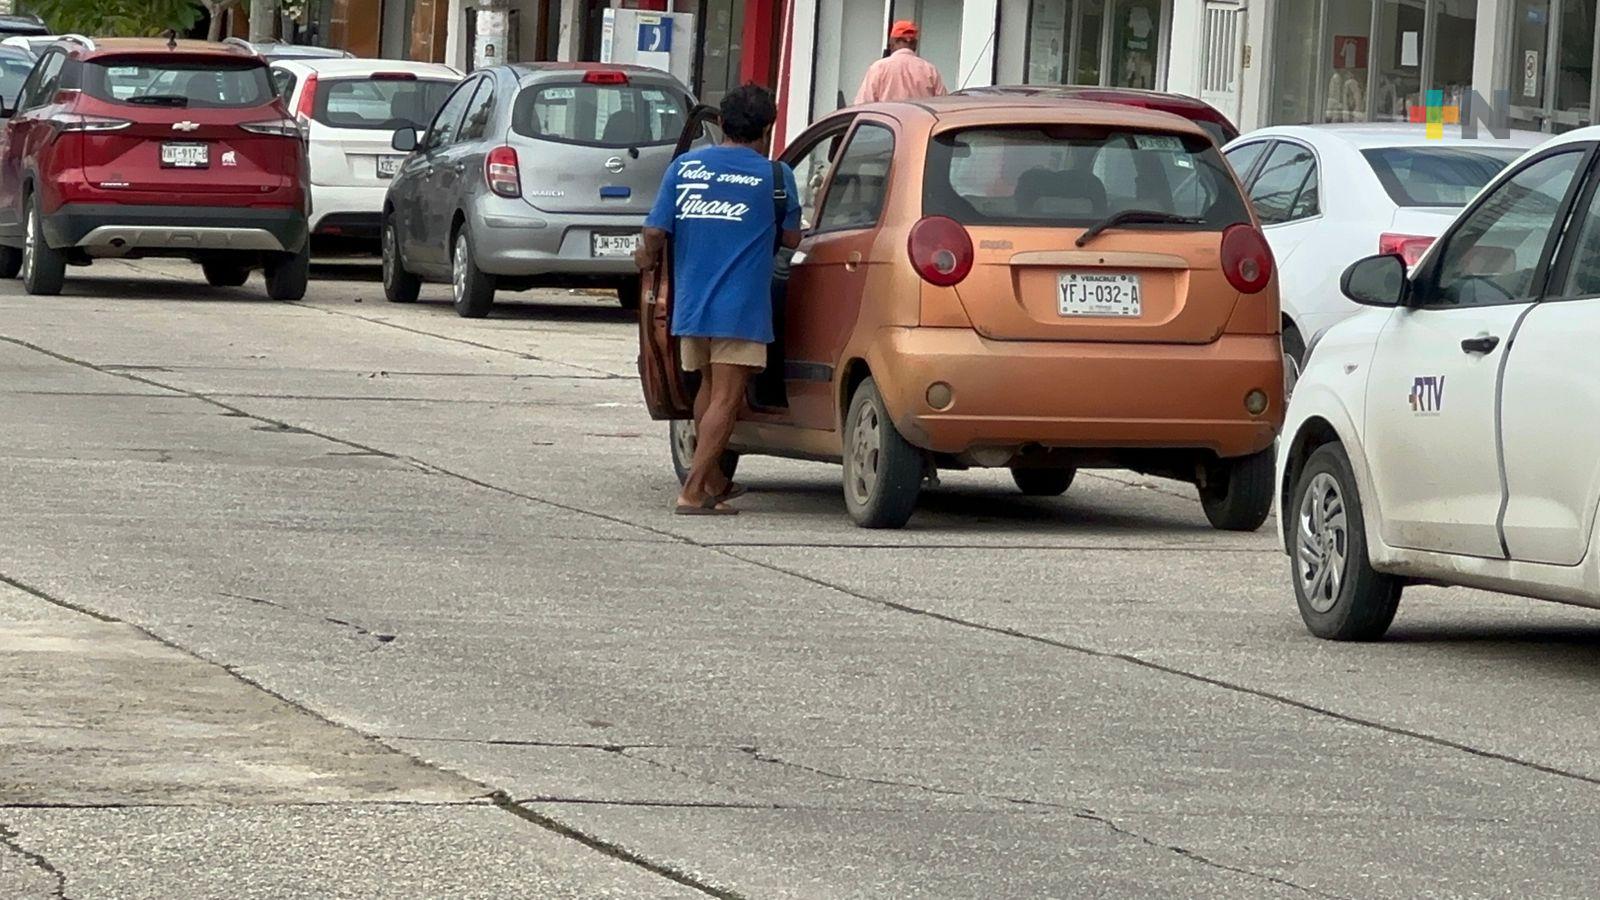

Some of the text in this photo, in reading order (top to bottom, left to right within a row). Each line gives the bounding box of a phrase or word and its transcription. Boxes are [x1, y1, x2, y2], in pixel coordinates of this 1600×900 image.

[678, 160, 764, 187] Todos somos
[1060, 283, 1139, 304] YFJ-032-A
[1411, 375, 1445, 411] RTV
